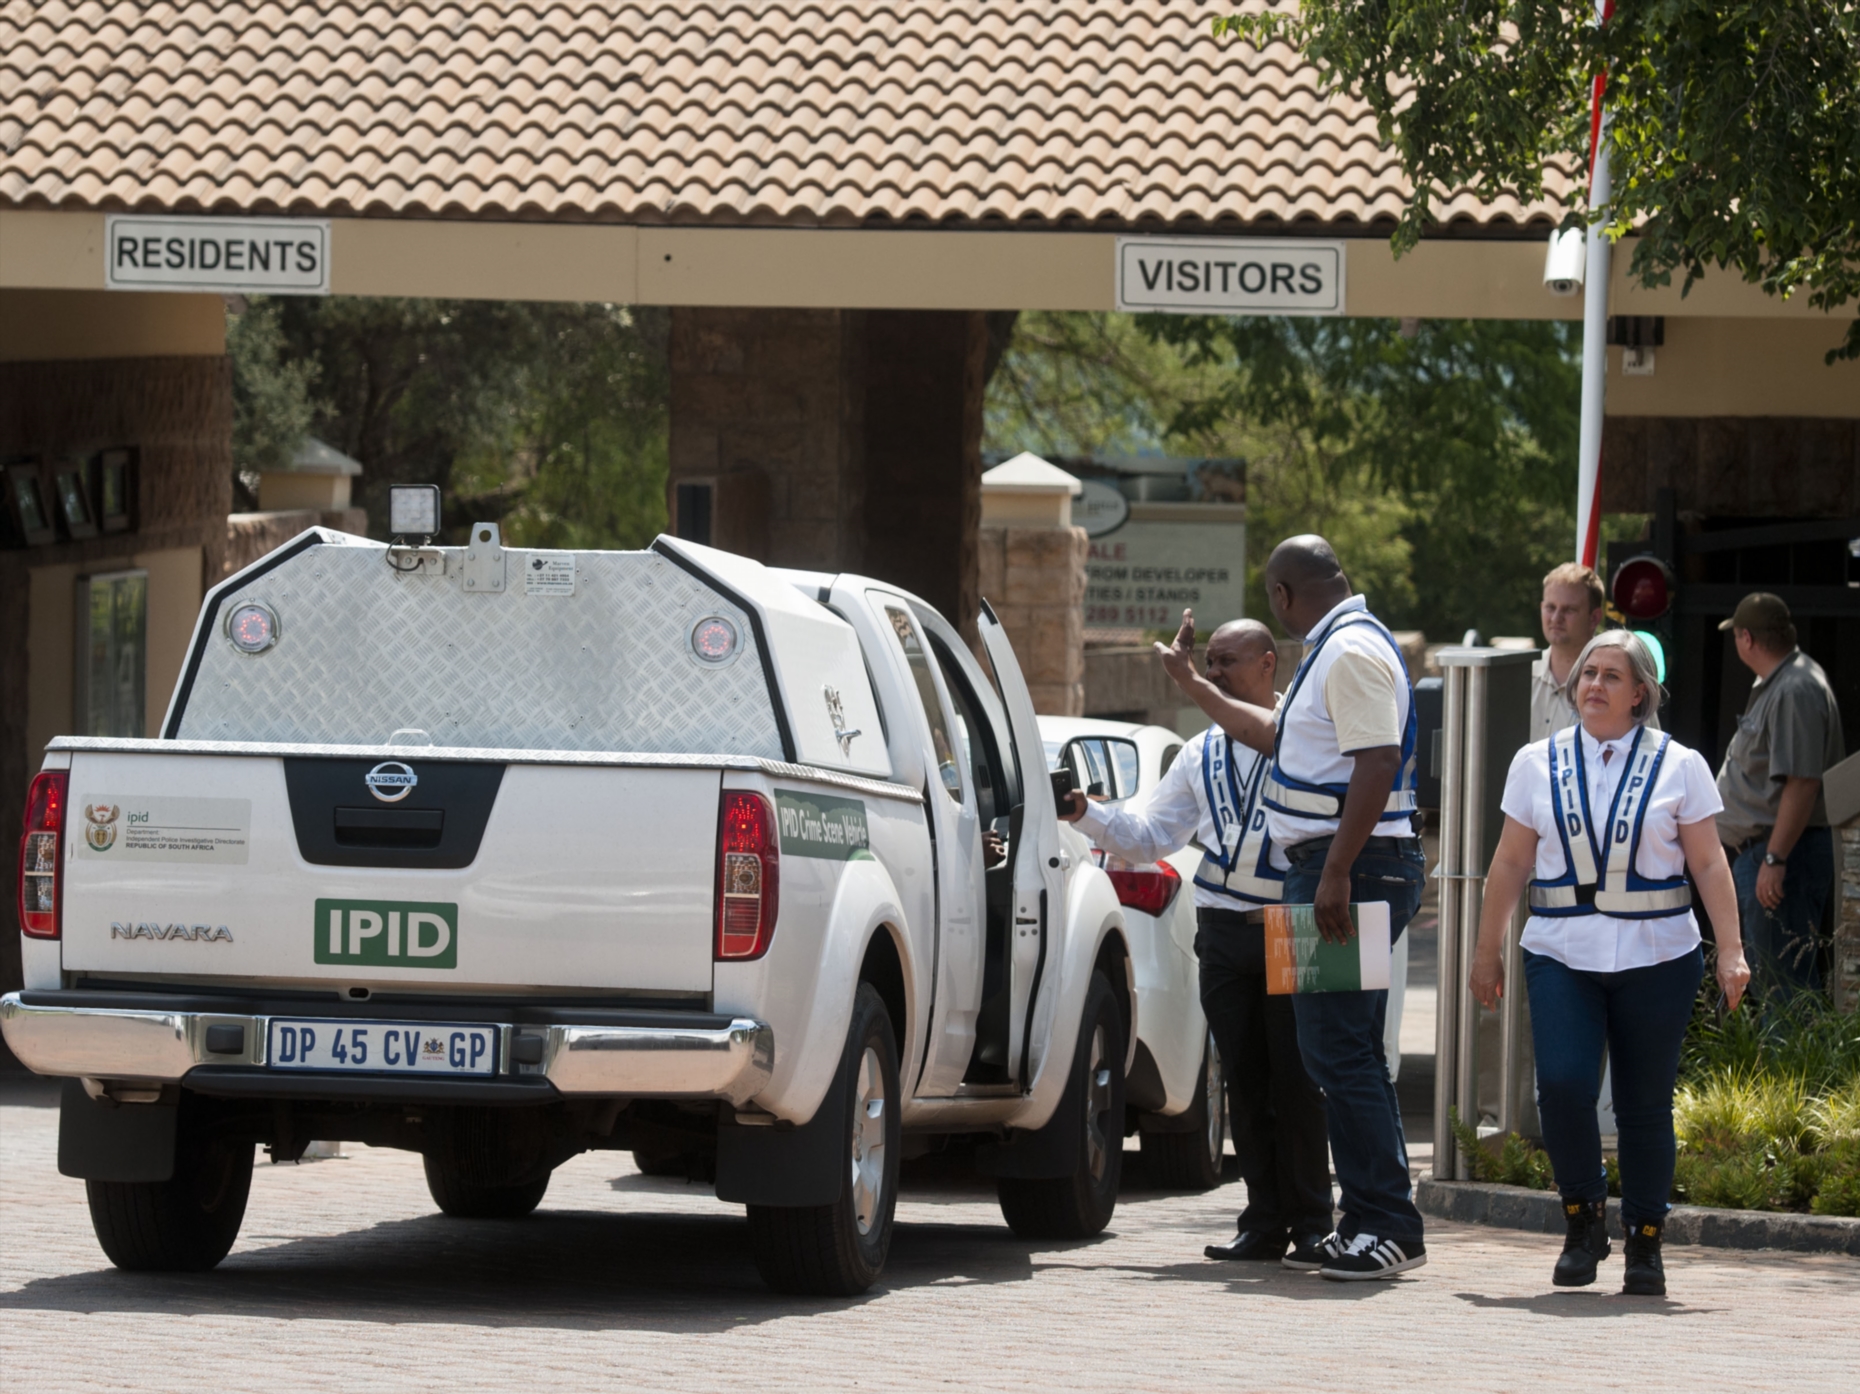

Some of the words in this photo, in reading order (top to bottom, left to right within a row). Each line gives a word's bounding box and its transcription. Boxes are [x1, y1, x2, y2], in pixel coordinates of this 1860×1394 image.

[117, 236, 317, 273] RESIDENTS
[1137, 258, 1323, 295] VISITORS
[1132, 567, 1230, 584] DEVELOPER
[1135, 588, 1200, 604] STANDS
[370, 775, 412, 784] NISSAN
[1562, 748, 1582, 837] IPID
[1615, 754, 1648, 844] IPID
[127, 811, 149, 825] ipid
[781, 807, 799, 838] IPID
[799, 809, 822, 842] Crime
[822, 812, 844, 845] Scene
[842, 815, 867, 848] Vehicle
[179, 837, 214, 845] Investigative
[110, 922, 233, 942] NAVARA
[329, 909, 451, 957] IPID
[279, 1026, 316, 1062] DP
[331, 1028, 368, 1064] 45
[384, 1030, 421, 1066] CV
[449, 1032, 486, 1068] GP
[1567, 1204, 1580, 1215] CAT
[1642, 1225, 1657, 1237] CAT
